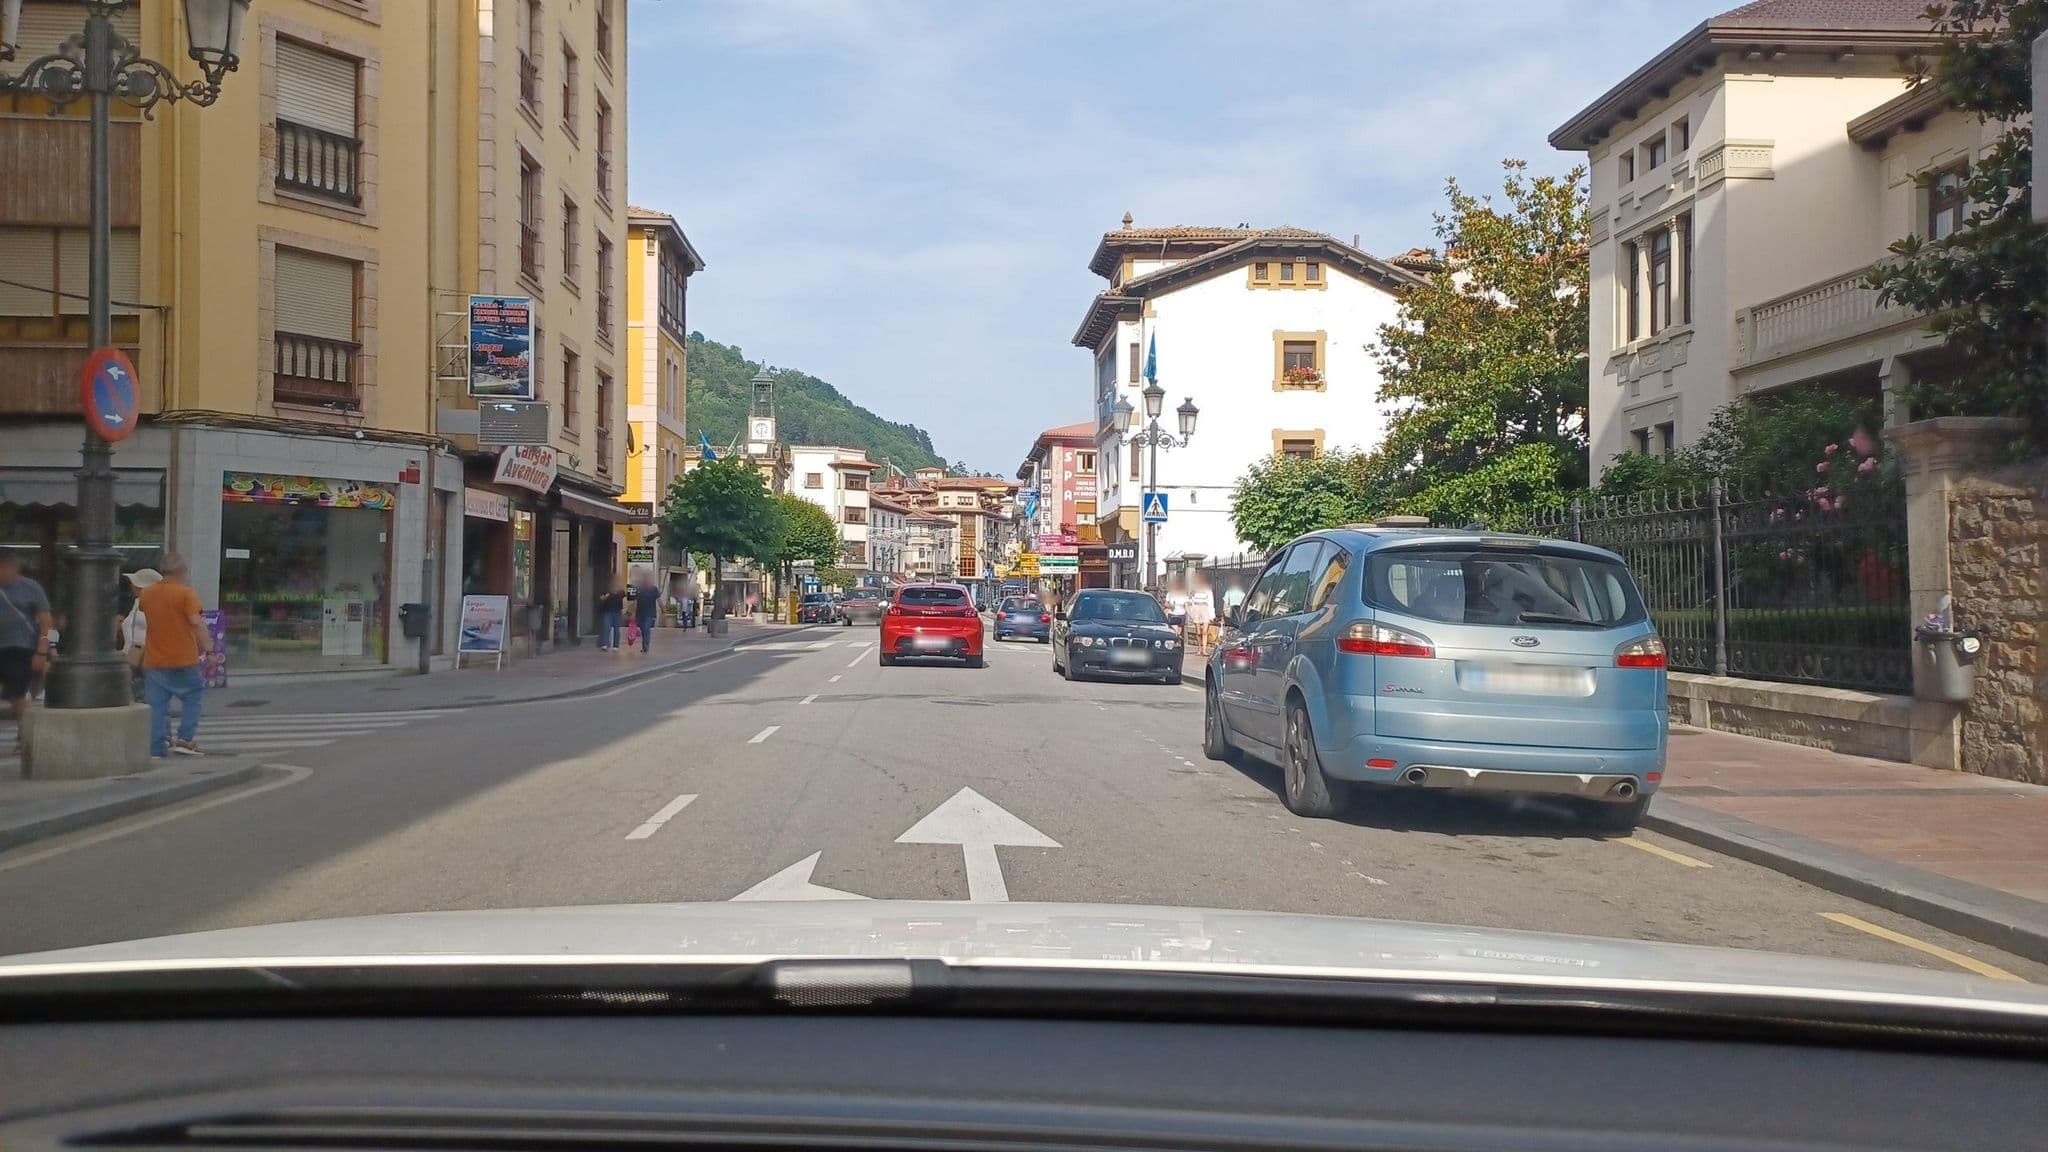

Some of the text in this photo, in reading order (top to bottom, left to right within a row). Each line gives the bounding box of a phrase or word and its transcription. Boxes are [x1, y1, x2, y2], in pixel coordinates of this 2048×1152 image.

[516, 445, 552, 467] Cangas
[502, 458, 549, 489] Aventura
[1041, 470, 1051, 534] HOTEL
